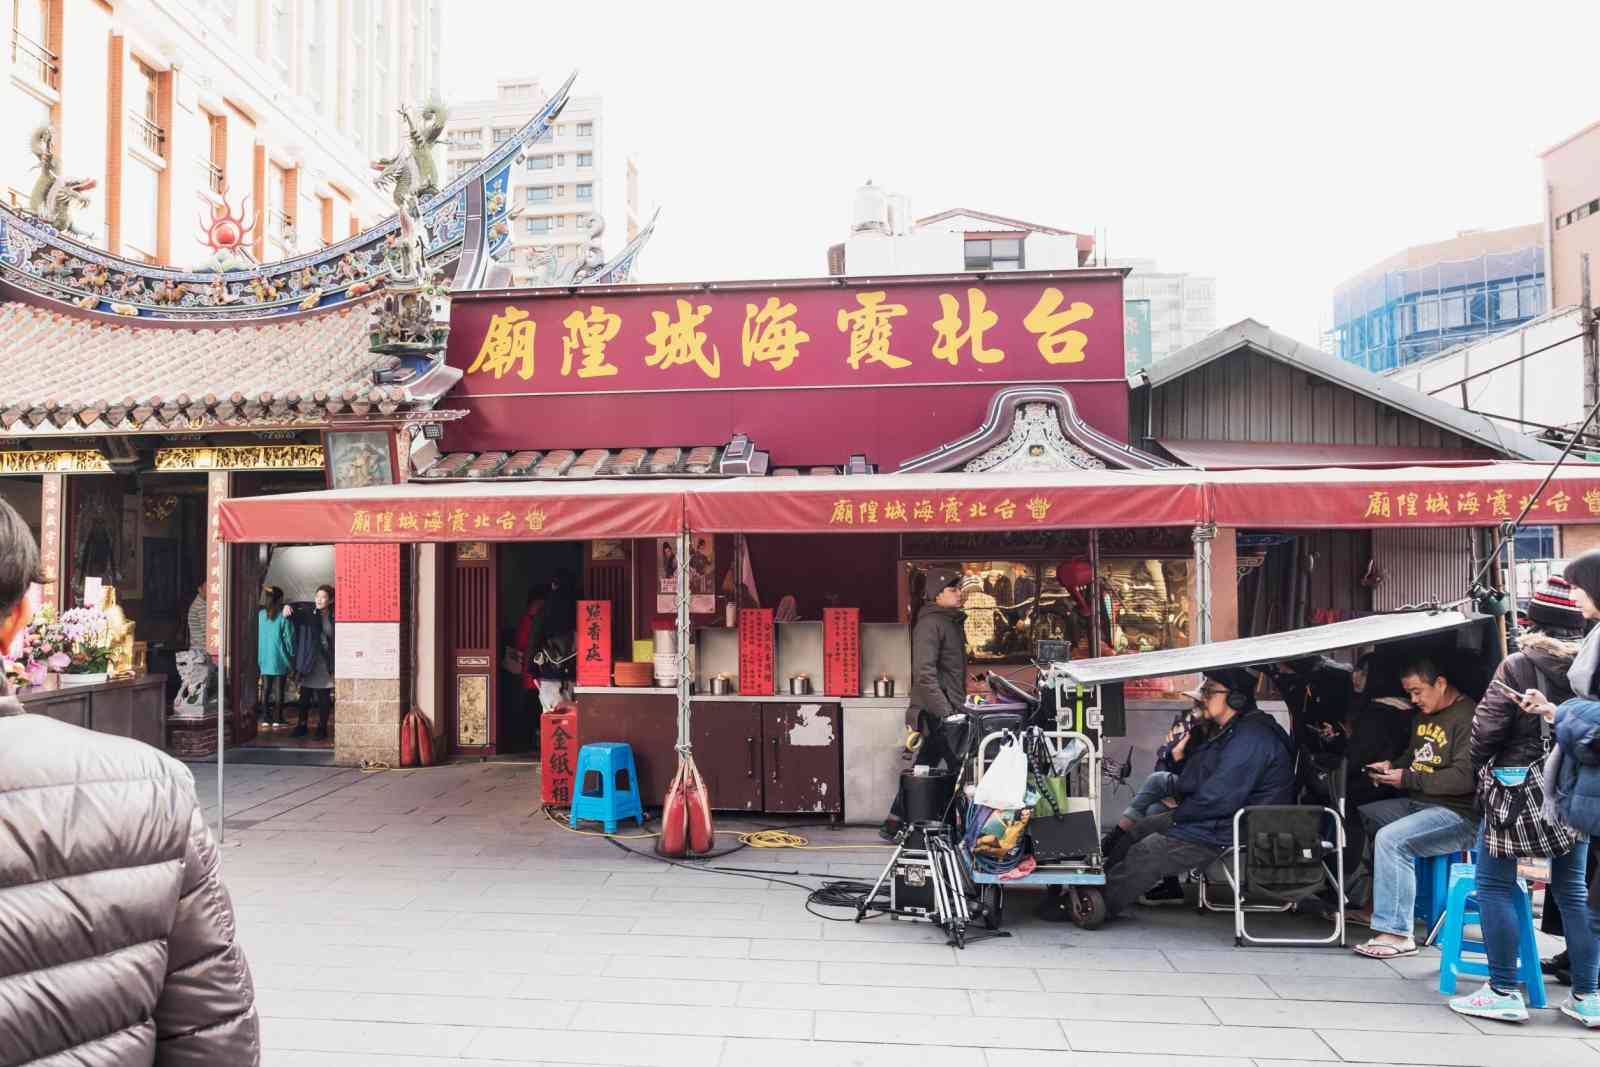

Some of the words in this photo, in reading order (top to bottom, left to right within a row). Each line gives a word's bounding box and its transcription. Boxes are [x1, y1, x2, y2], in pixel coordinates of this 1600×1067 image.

[467, 287, 1094, 381] 台北霞海城隍廟
[549, 725, 574, 802] 金紙箱
